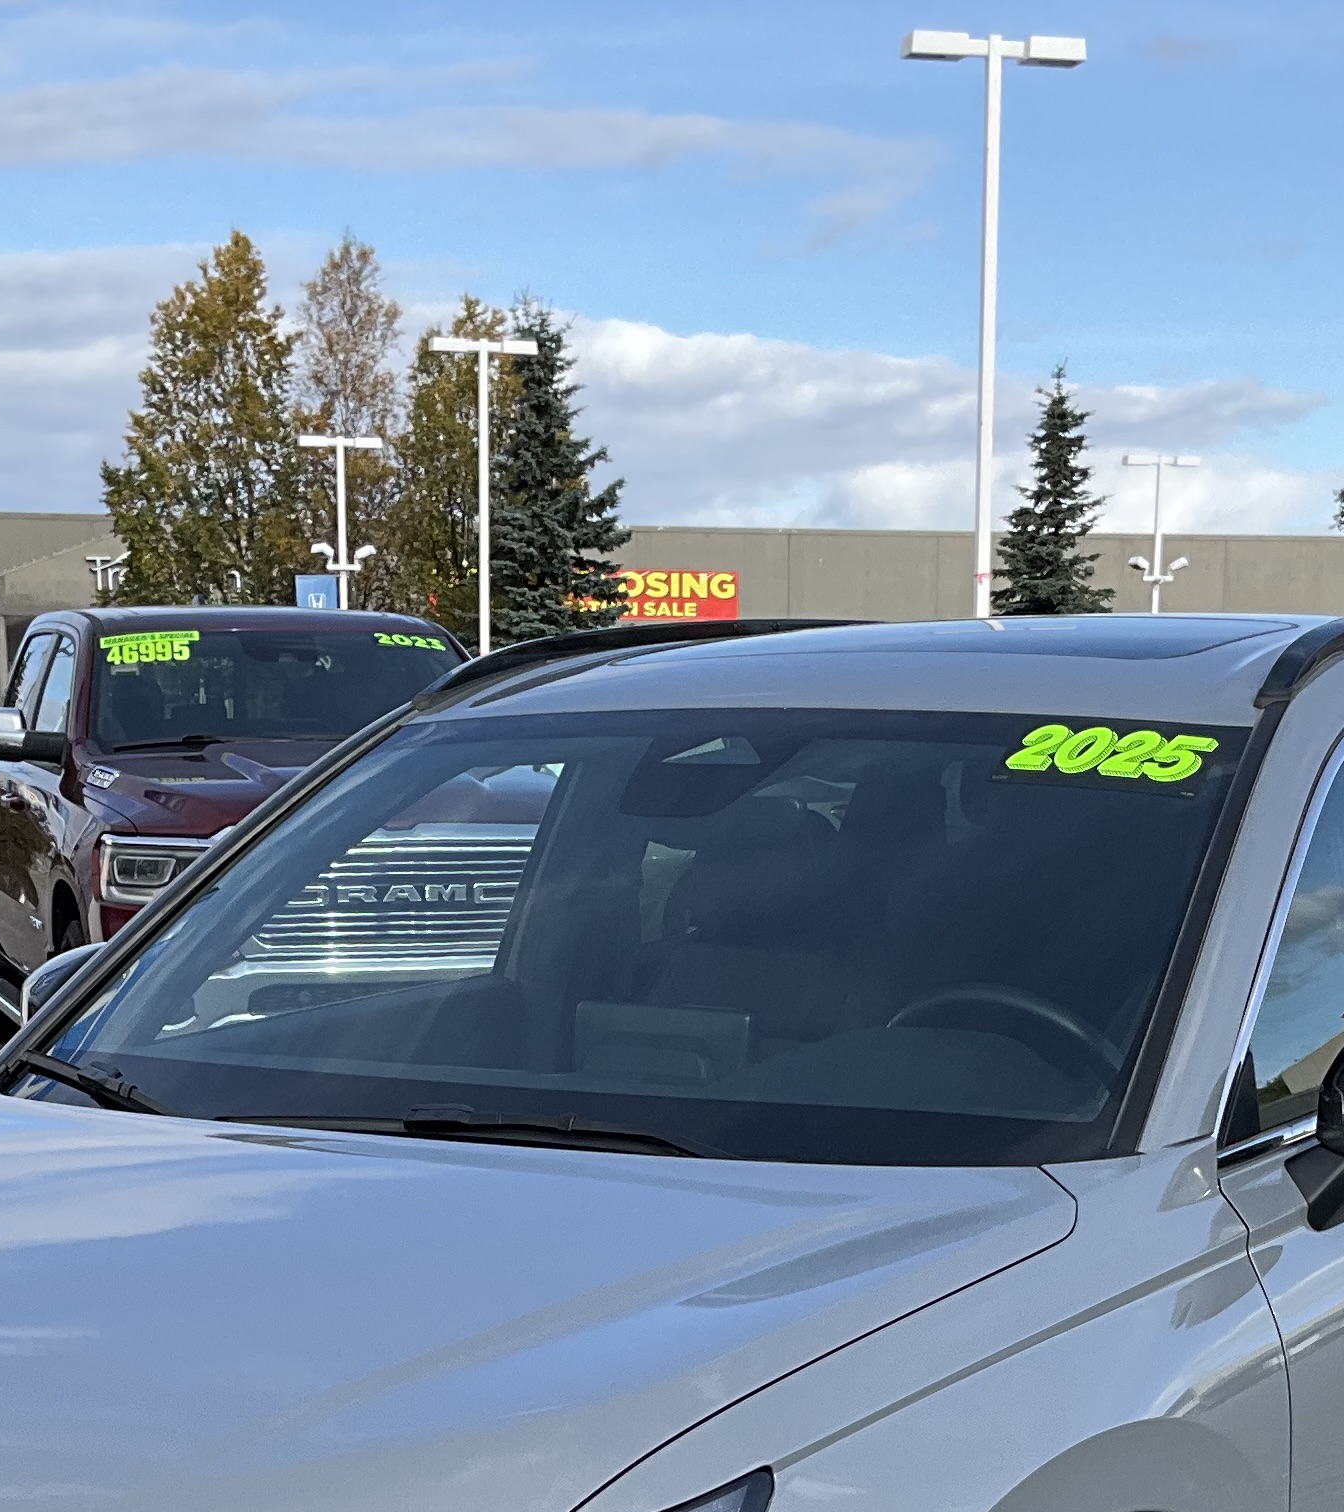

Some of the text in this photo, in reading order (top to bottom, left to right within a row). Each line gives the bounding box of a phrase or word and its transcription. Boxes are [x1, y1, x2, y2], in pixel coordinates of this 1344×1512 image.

[618, 571, 736, 600] OSING
[644, 602, 697, 617] SALE
[106, 640, 191, 666] 46995
[373, 632, 446, 652] 2023
[1005, 724, 1220, 783] 2025
[336, 884, 467, 904] RAM
